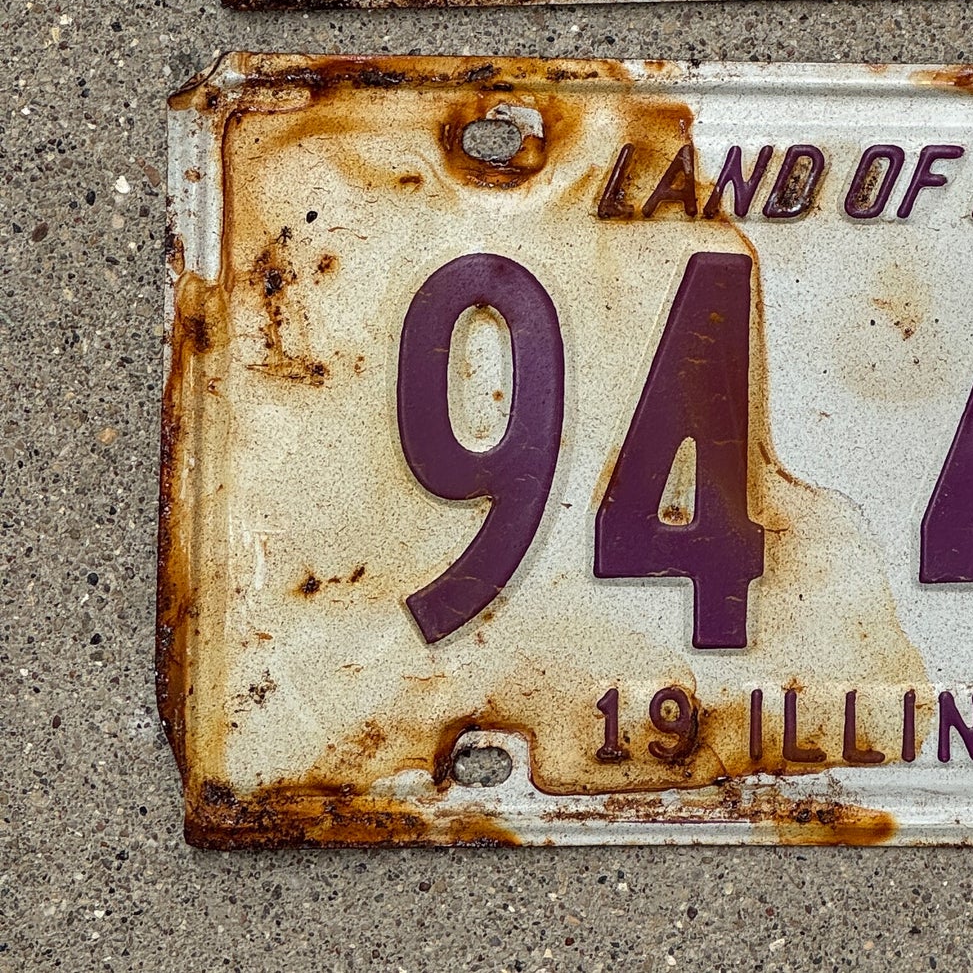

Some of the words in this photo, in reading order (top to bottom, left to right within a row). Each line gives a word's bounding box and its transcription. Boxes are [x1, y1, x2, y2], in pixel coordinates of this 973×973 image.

[598, 143, 824, 220] LAND
[844, 144, 965, 220] OF
[397, 252, 764, 649] 94
[595, 687, 699, 766] 19
